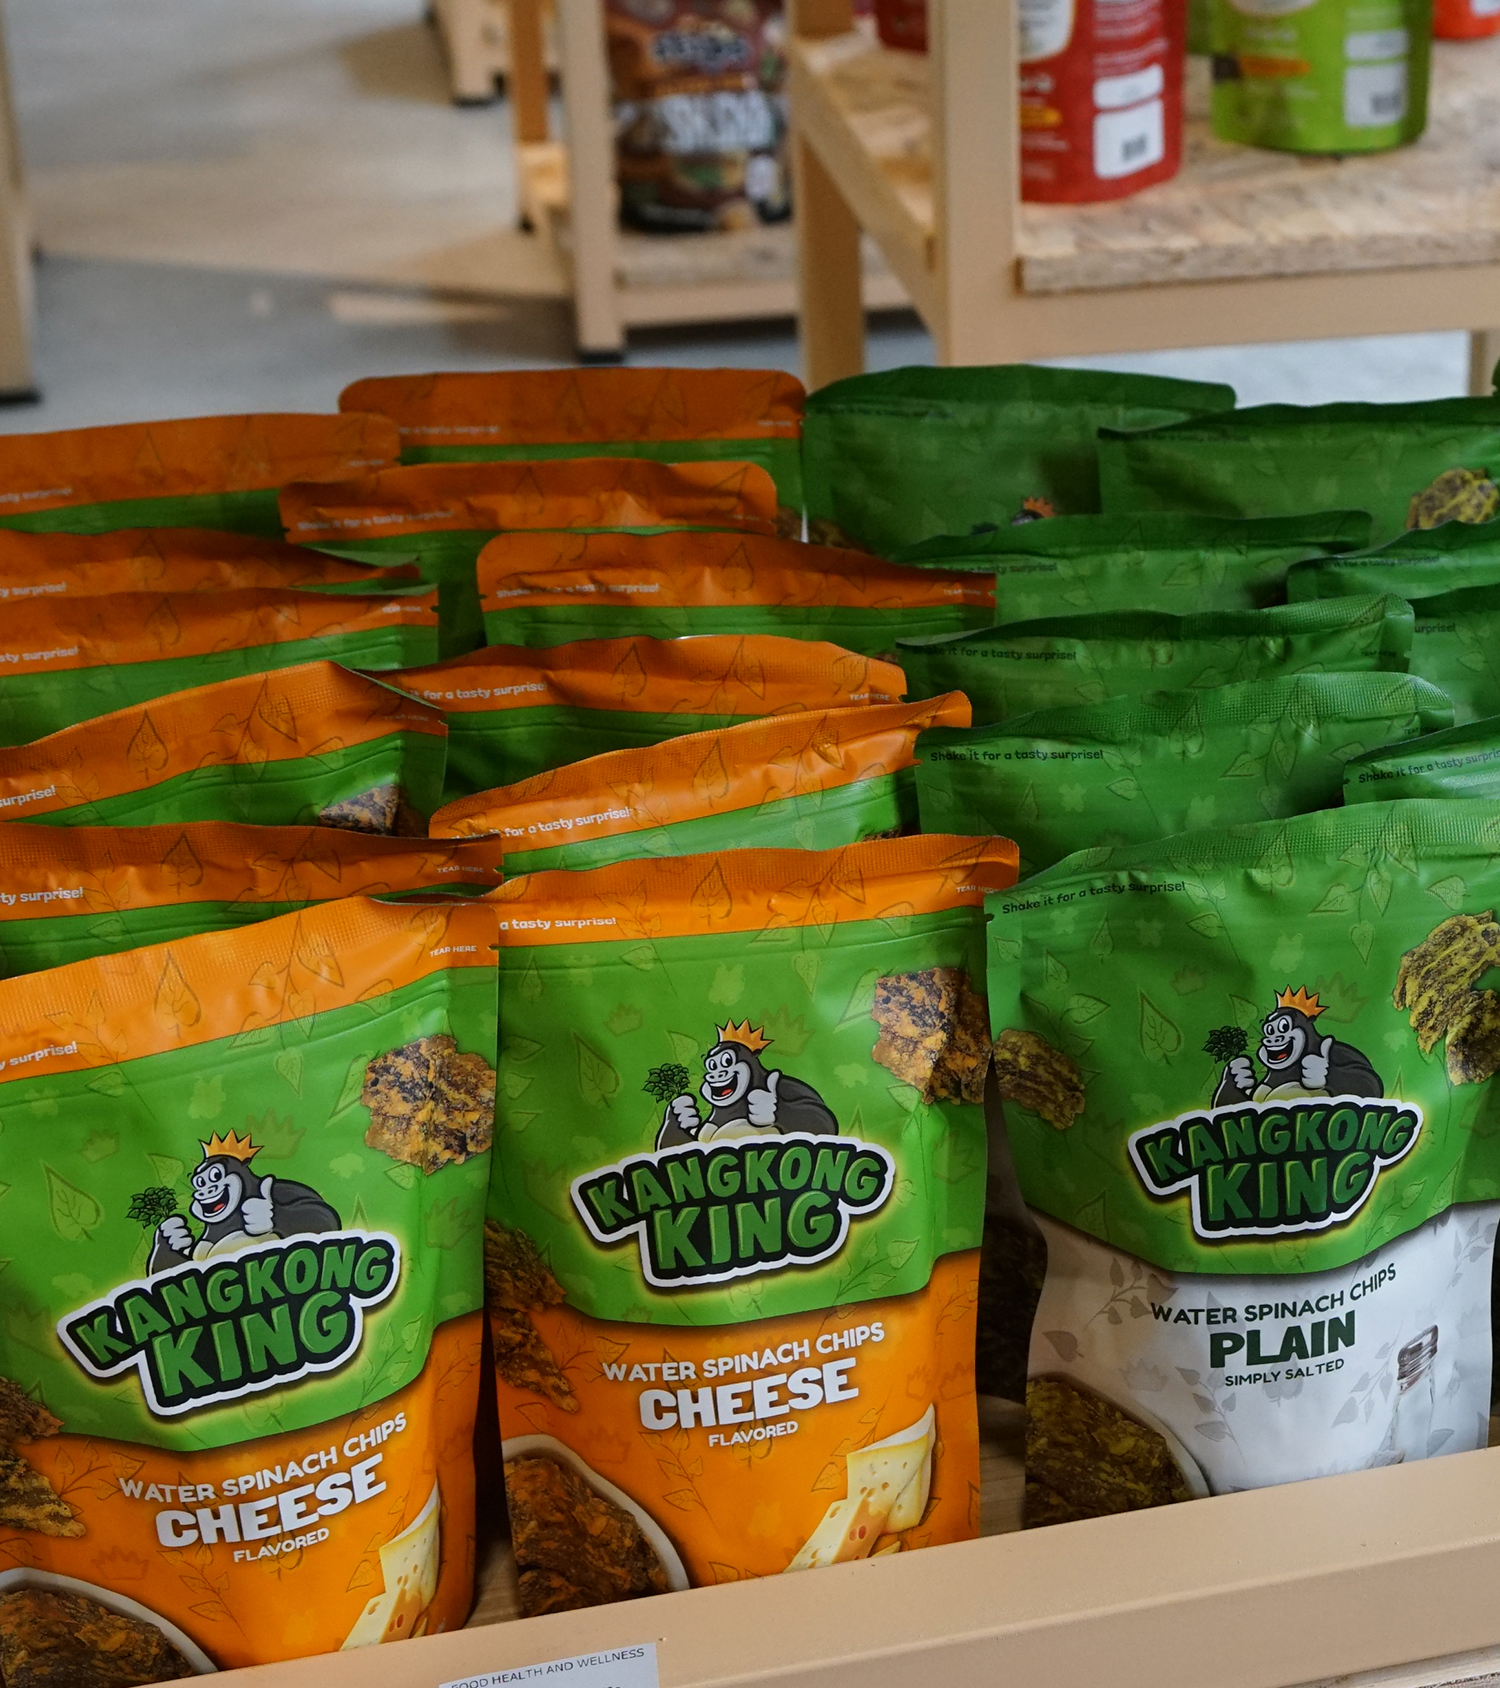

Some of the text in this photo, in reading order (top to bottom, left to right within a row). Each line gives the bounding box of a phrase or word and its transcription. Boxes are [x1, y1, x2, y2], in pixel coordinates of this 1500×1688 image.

[1414, 621, 1458, 636] urprise!
[21, 645, 79, 662] surprise!
[961, 646, 979, 658] for
[981, 649, 991, 659] a
[991, 648, 1024, 662] tasty
[1025, 648, 1078, 662] surprise!
[423, 685, 443, 700] for
[445, 689, 456, 699] a
[456, 685, 491, 700] tasty
[930, 749, 1103, 764] Shake it for a tasty surprise!
[1358, 766, 1395, 784] Shake
[1396, 764, 1407, 778] it
[1408, 762, 1426, 776] for
[1426, 762, 1436, 773] a
[1434, 756, 1465, 772] tasty
[503, 827, 525, 839] for
[528, 826, 540, 837] a
[540, 815, 574, 836] tasty
[575, 806, 632, 828] surprise!
[19, 886, 85, 905] surprise!
[1002, 880, 1187, 915] Shake it for a tasty surprise!
[500, 914, 618, 931] a tasty surprise!
[430, 944, 478, 957] TEAR HERE
[9, 1040, 79, 1067] surprise!
[1142, 1108, 1417, 1183] KANGKONG
[585, 1144, 884, 1229] KANGKONG
[1205, 1150, 1373, 1223] KING
[651, 1189, 836, 1271] KING
[72, 1242, 397, 1367] KANGKONG
[1150, 1262, 1398, 1327] WATER SPINACH CHIPS
[150, 1288, 353, 1399] KING
[601, 1320, 887, 1384] WATER SPINACH CHIPS
[1208, 1309, 1358, 1370] PLAIN
[1224, 1357, 1346, 1388] SIMPLY SALTED
[637, 1356, 861, 1431] CHEESE
[707, 1419, 800, 1449] FLAVORED
[118, 1411, 409, 1505] WATER SPINACH CHIPS
[154, 1451, 390, 1550] CHEESE
[232, 1525, 331, 1564] FLAVORED
[491, 1667, 544, 1685] HEALTH
[546, 1660, 574, 1676] AND
[576, 1646, 645, 1669] WELLNESS
